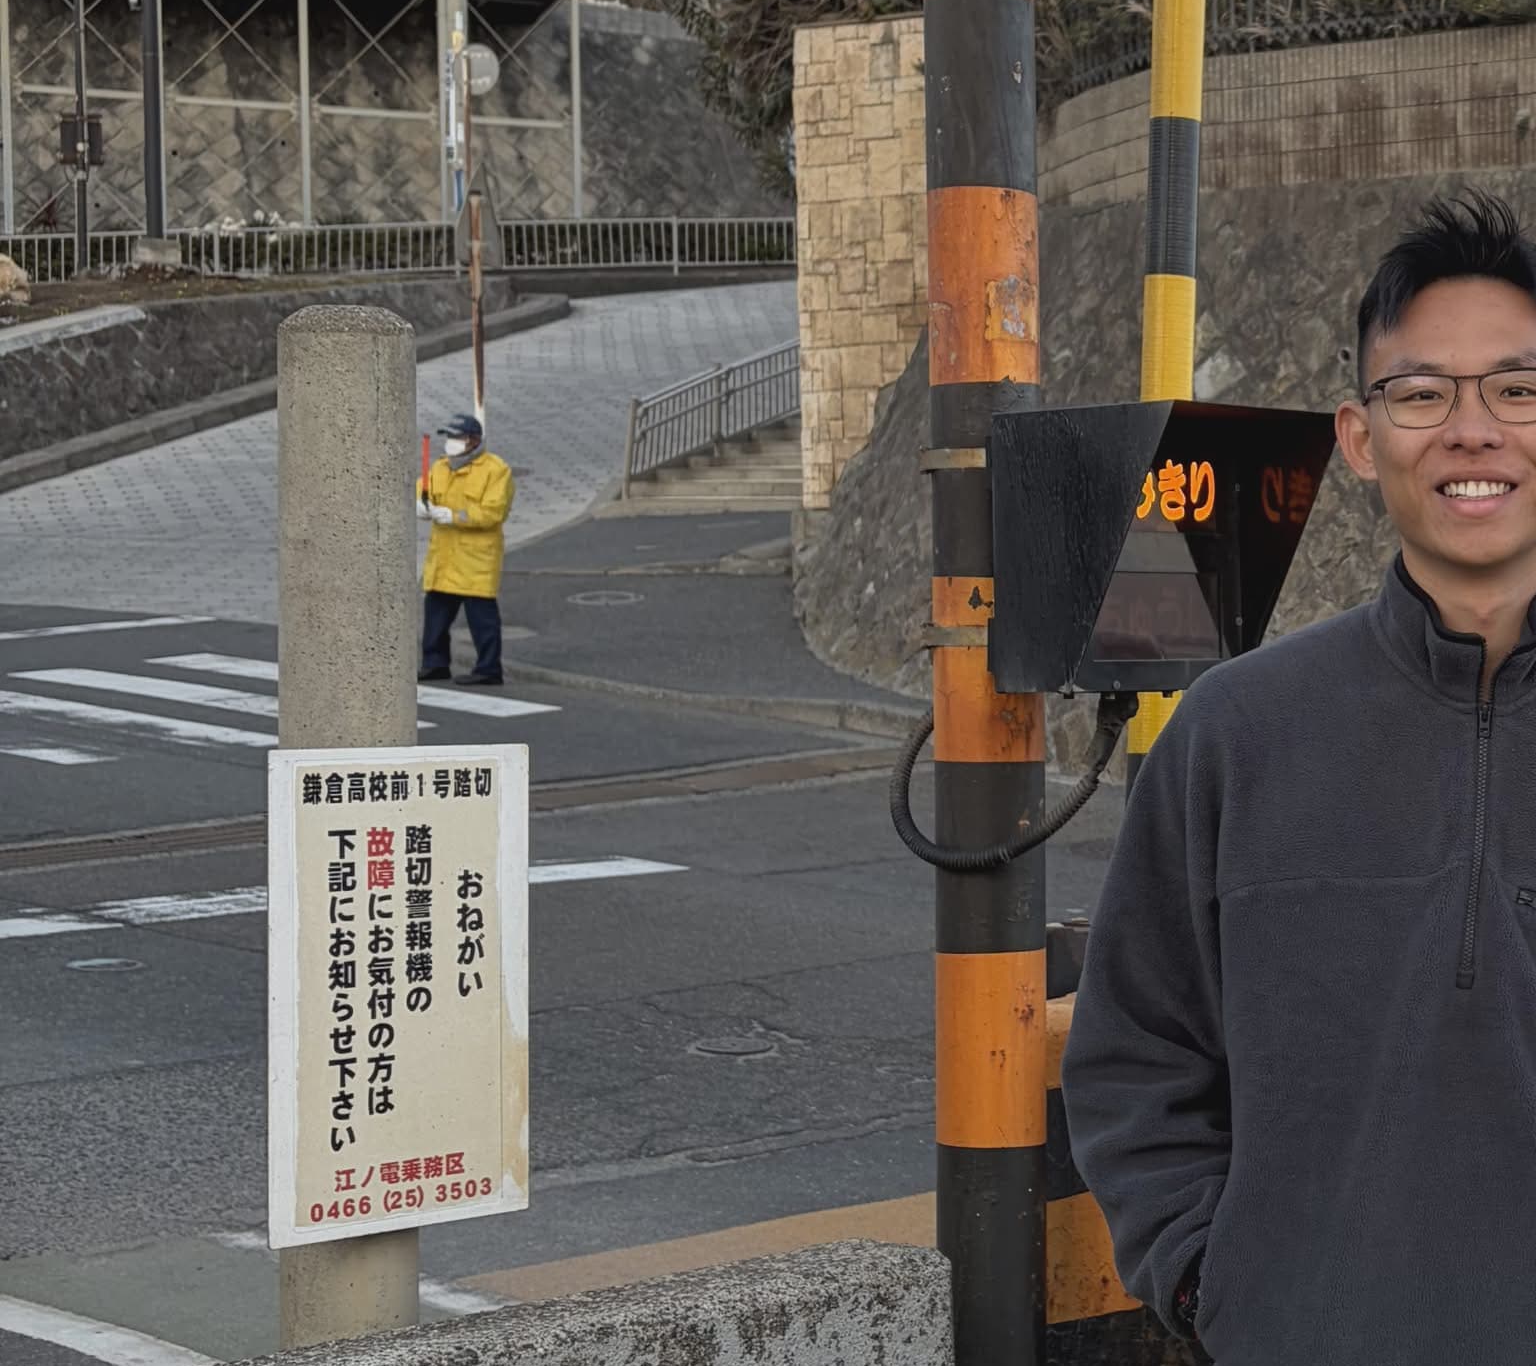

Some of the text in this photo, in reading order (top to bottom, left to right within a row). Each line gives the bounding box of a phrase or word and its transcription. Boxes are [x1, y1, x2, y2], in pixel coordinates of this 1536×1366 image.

[303, 768, 491, 804] 鎌倉高校前1号踏切
[367, 827, 395, 1115] 故障にお気付の方は
[405, 825, 432, 1012] 踏切警報機の
[457, 869, 484, 997] おねがい
[328, 829, 357, 1152] 下記にお知らせ下さい
[311, 1177, 492, 1222] 0466 (25) 3503
[334, 1152, 464, 1192] 江ノ電乗務区
